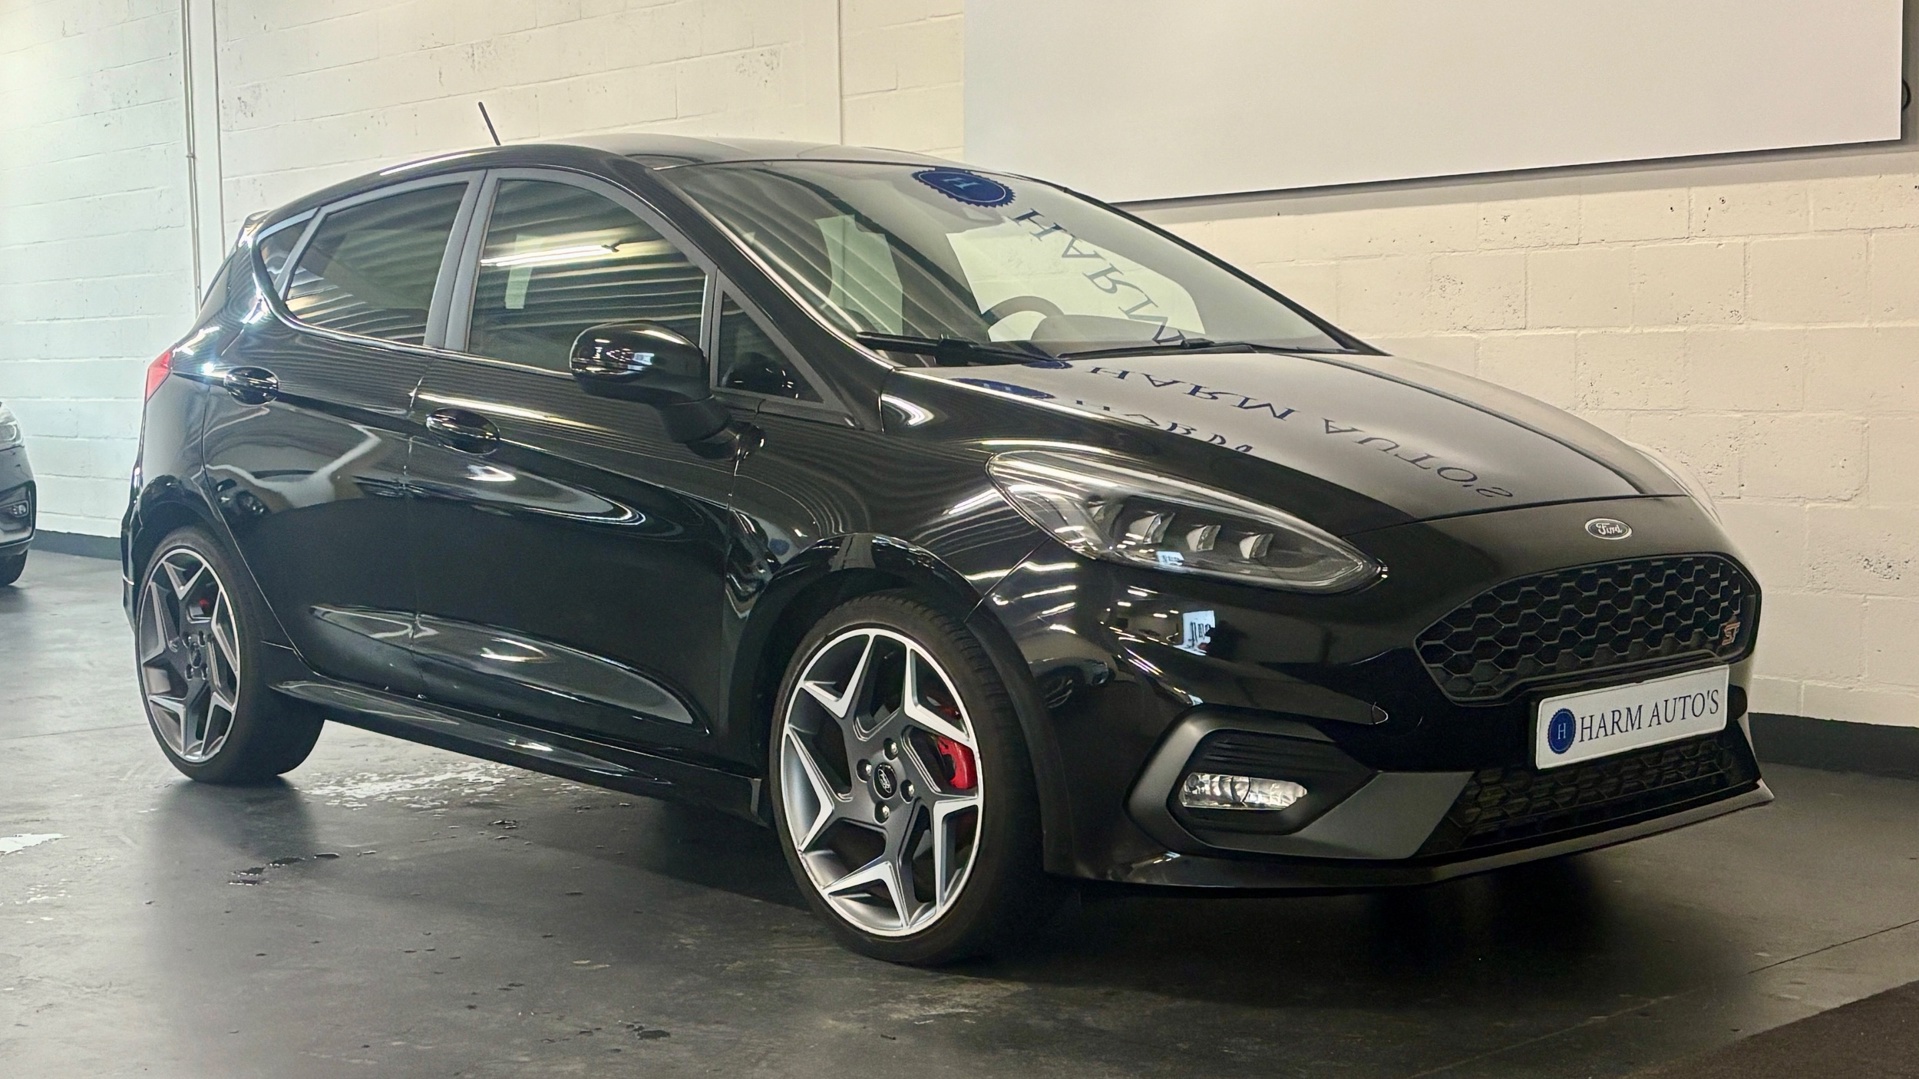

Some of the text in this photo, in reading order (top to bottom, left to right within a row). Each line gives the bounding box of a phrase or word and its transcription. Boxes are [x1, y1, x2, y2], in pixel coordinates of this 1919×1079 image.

[1595, 522, 1622, 535] Ford
[1721, 621, 1741, 646] ST
[1557, 689, 1719, 743] H HARM AUTO'S
